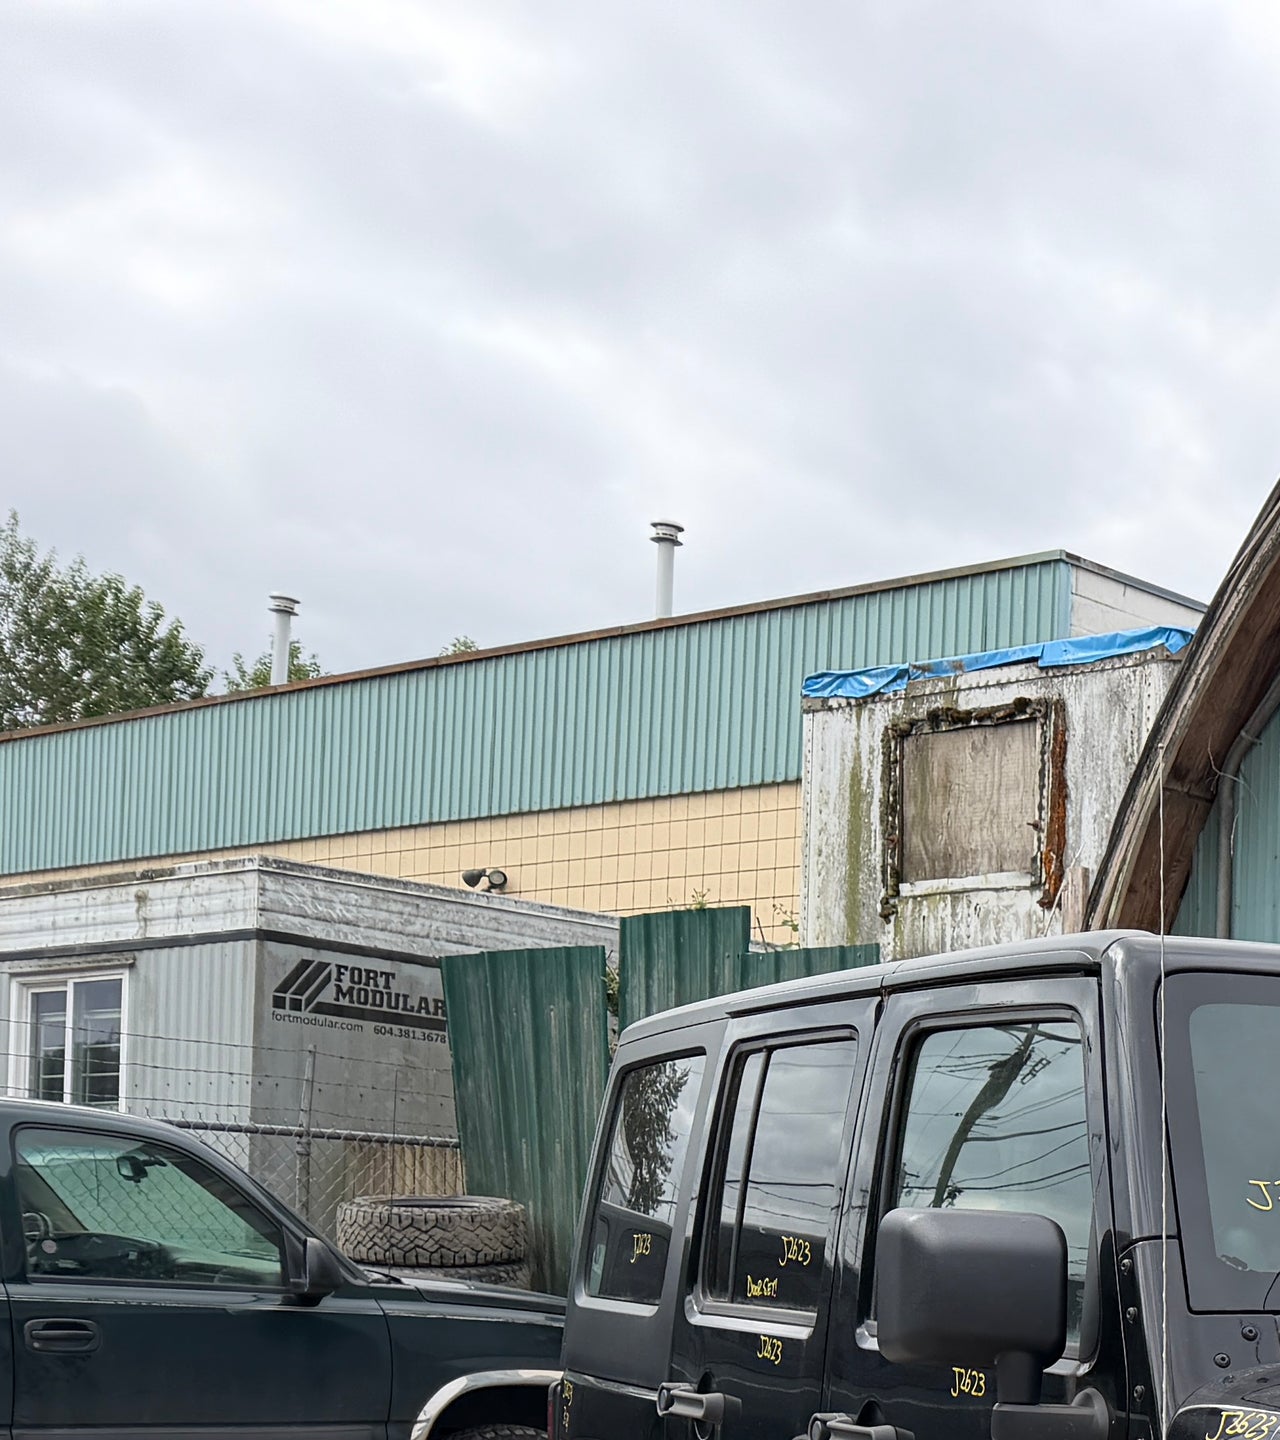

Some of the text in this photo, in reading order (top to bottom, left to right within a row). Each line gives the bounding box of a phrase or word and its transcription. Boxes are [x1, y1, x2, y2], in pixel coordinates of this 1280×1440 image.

[334, 963, 395, 990] FORT
[333, 983, 447, 1017] MODULAR
[271, 1010, 447, 1044] fortmodular.com 604.381.3678
[778, 1235, 812, 1267] J2623
[756, 1334, 783, 1365] J2623
[950, 1366, 986, 1398] J2623
